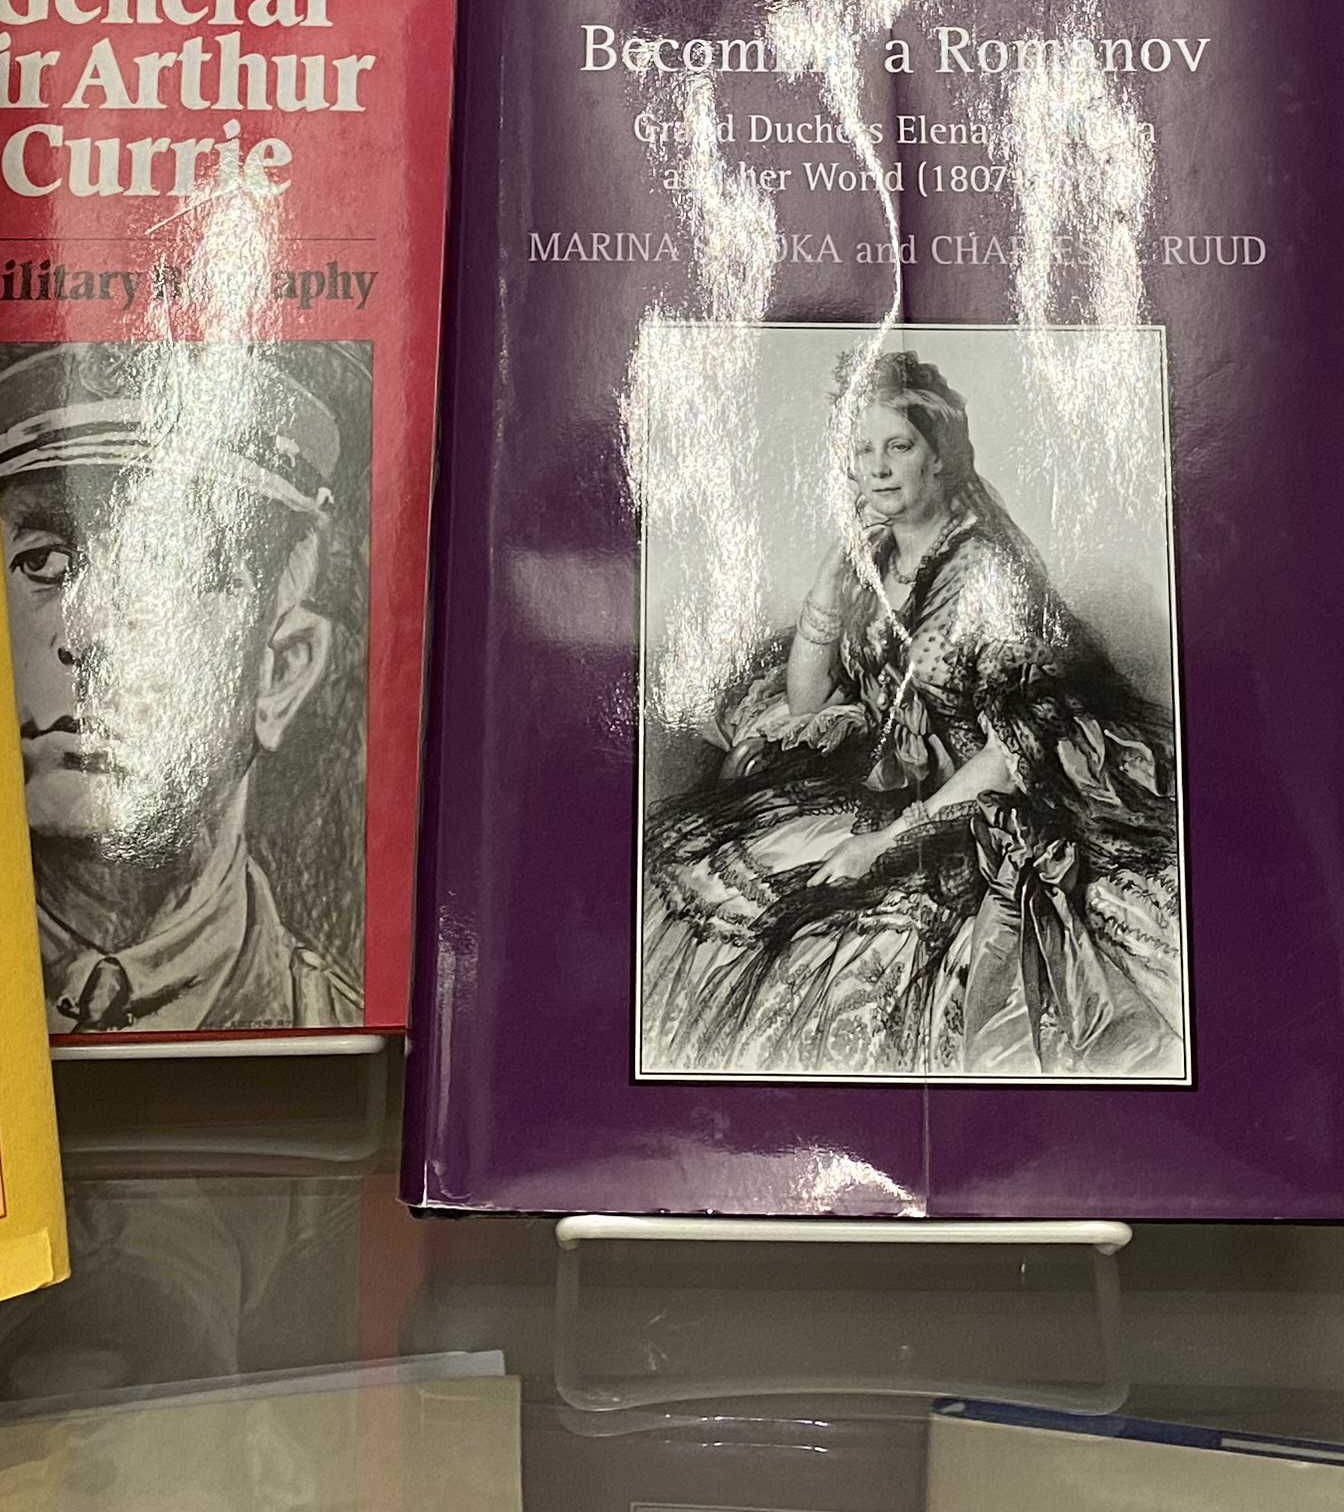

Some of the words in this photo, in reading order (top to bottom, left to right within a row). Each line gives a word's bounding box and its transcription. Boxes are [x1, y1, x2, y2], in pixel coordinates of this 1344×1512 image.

[62, 31, 376, 112] Arthur
[884, 40, 915, 73] a
[935, 26, 1212, 74] Romanov
[748, 114, 884, 144] Duches
[897, 115, 988, 144] Elena
[1, 119, 293, 197] Currie
[528, 232, 681, 262] MARINA
[856, 235, 917, 264] and
[1160, 235, 1267, 265] RUUD
